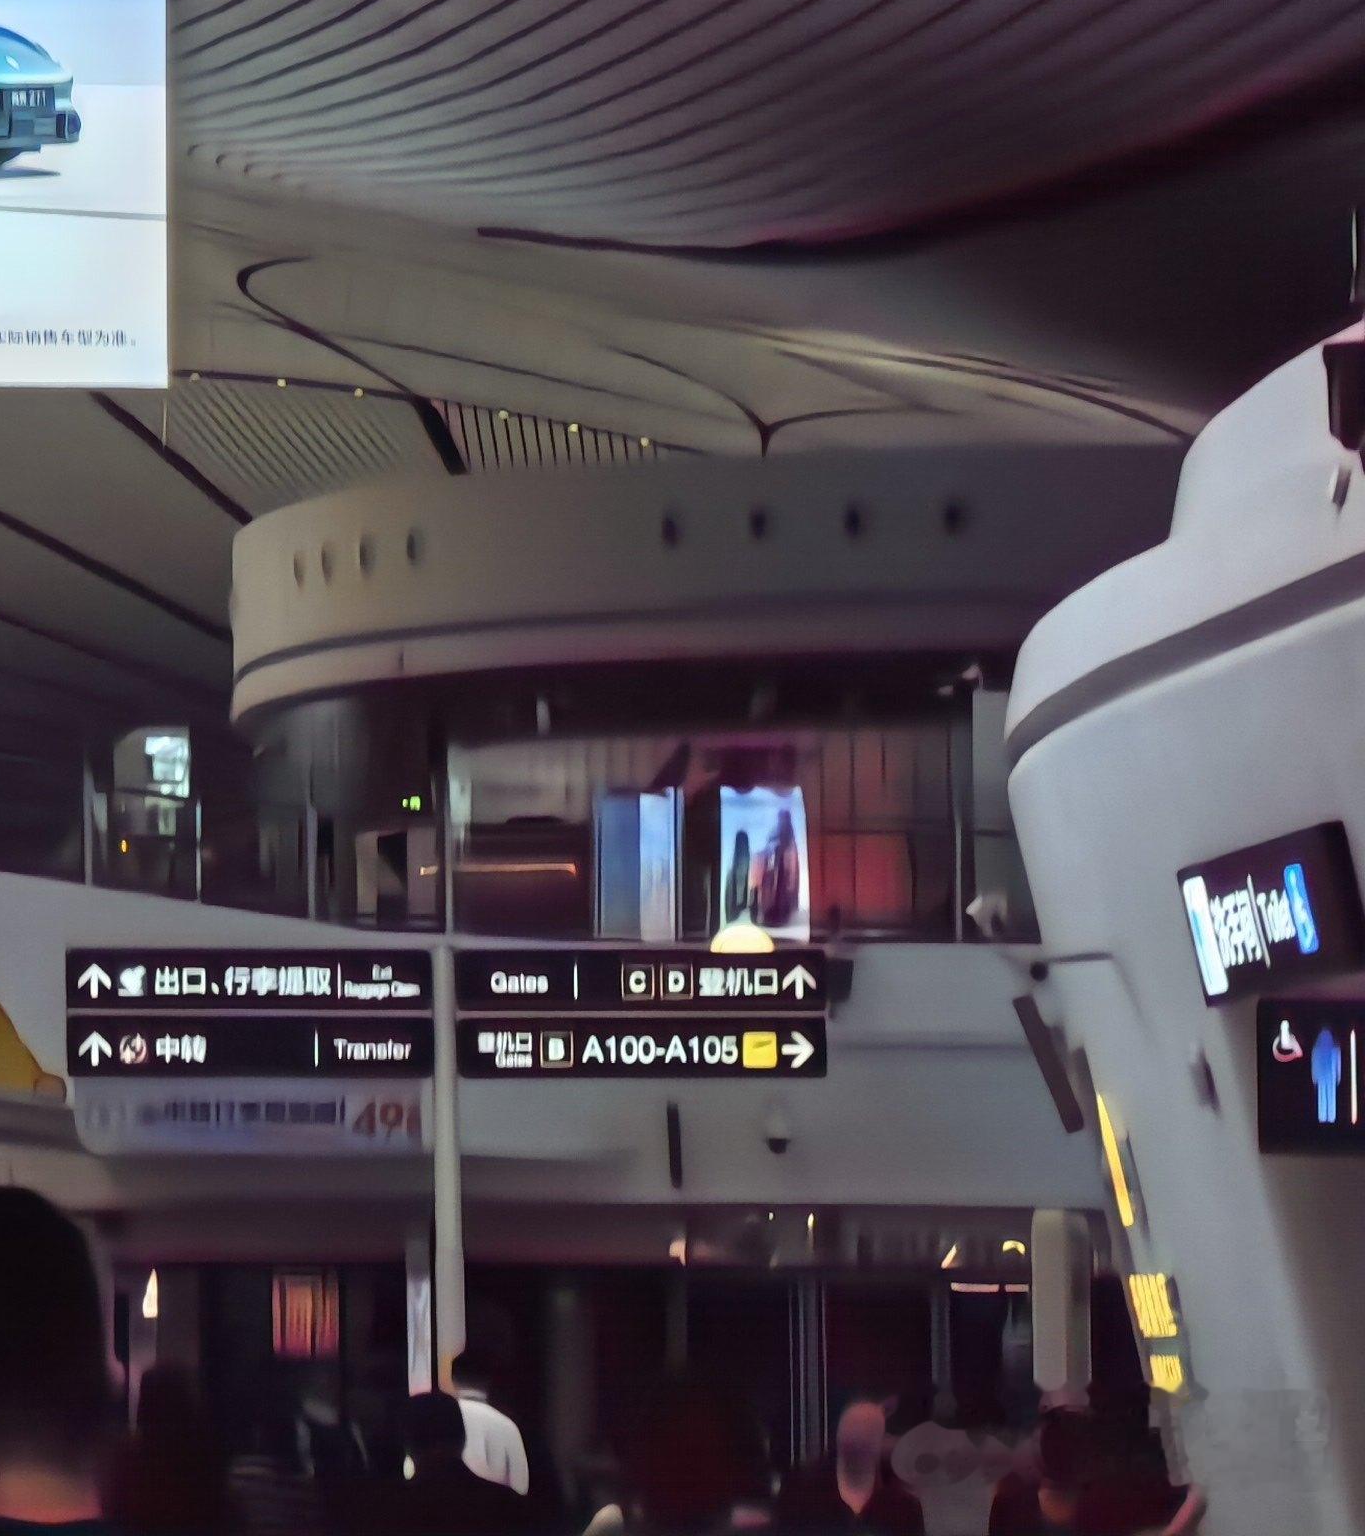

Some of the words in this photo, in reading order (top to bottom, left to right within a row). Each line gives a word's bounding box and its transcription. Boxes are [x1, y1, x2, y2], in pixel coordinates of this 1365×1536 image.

[629, 970, 647, 994] C
[669, 970, 685, 994] D
[334, 1037, 412, 1061] Transfer
[582, 1035, 739, 1066] A100-A105
